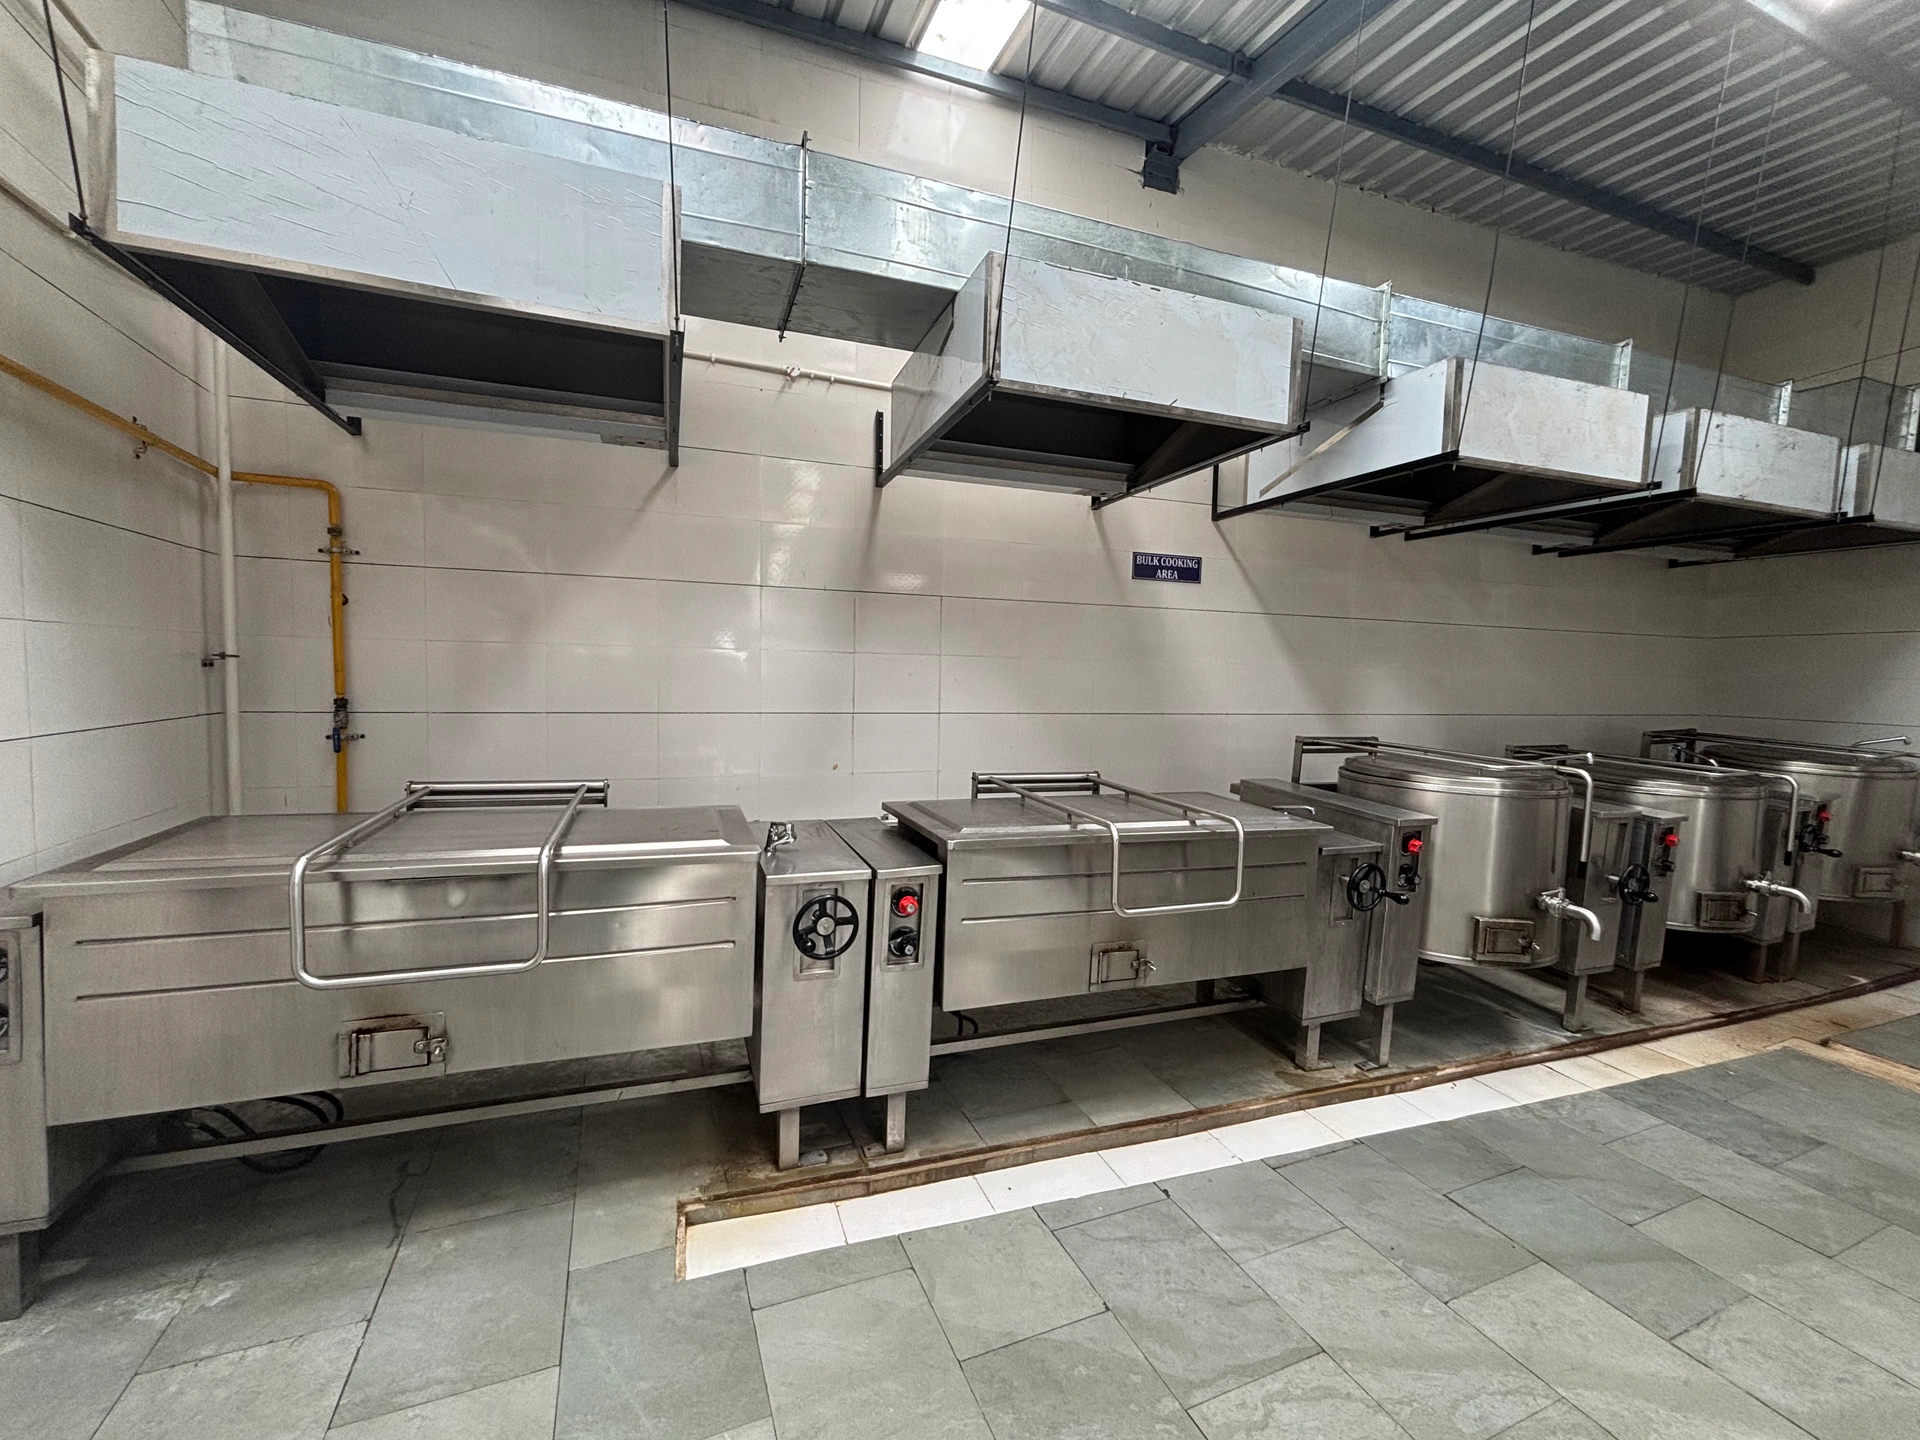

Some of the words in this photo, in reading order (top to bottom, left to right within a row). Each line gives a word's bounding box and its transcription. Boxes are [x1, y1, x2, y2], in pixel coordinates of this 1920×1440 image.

[1136, 555, 1160, 566] BULK
[1160, 557, 1198, 569] COOKING
[1156, 569, 1178, 580] AREA
